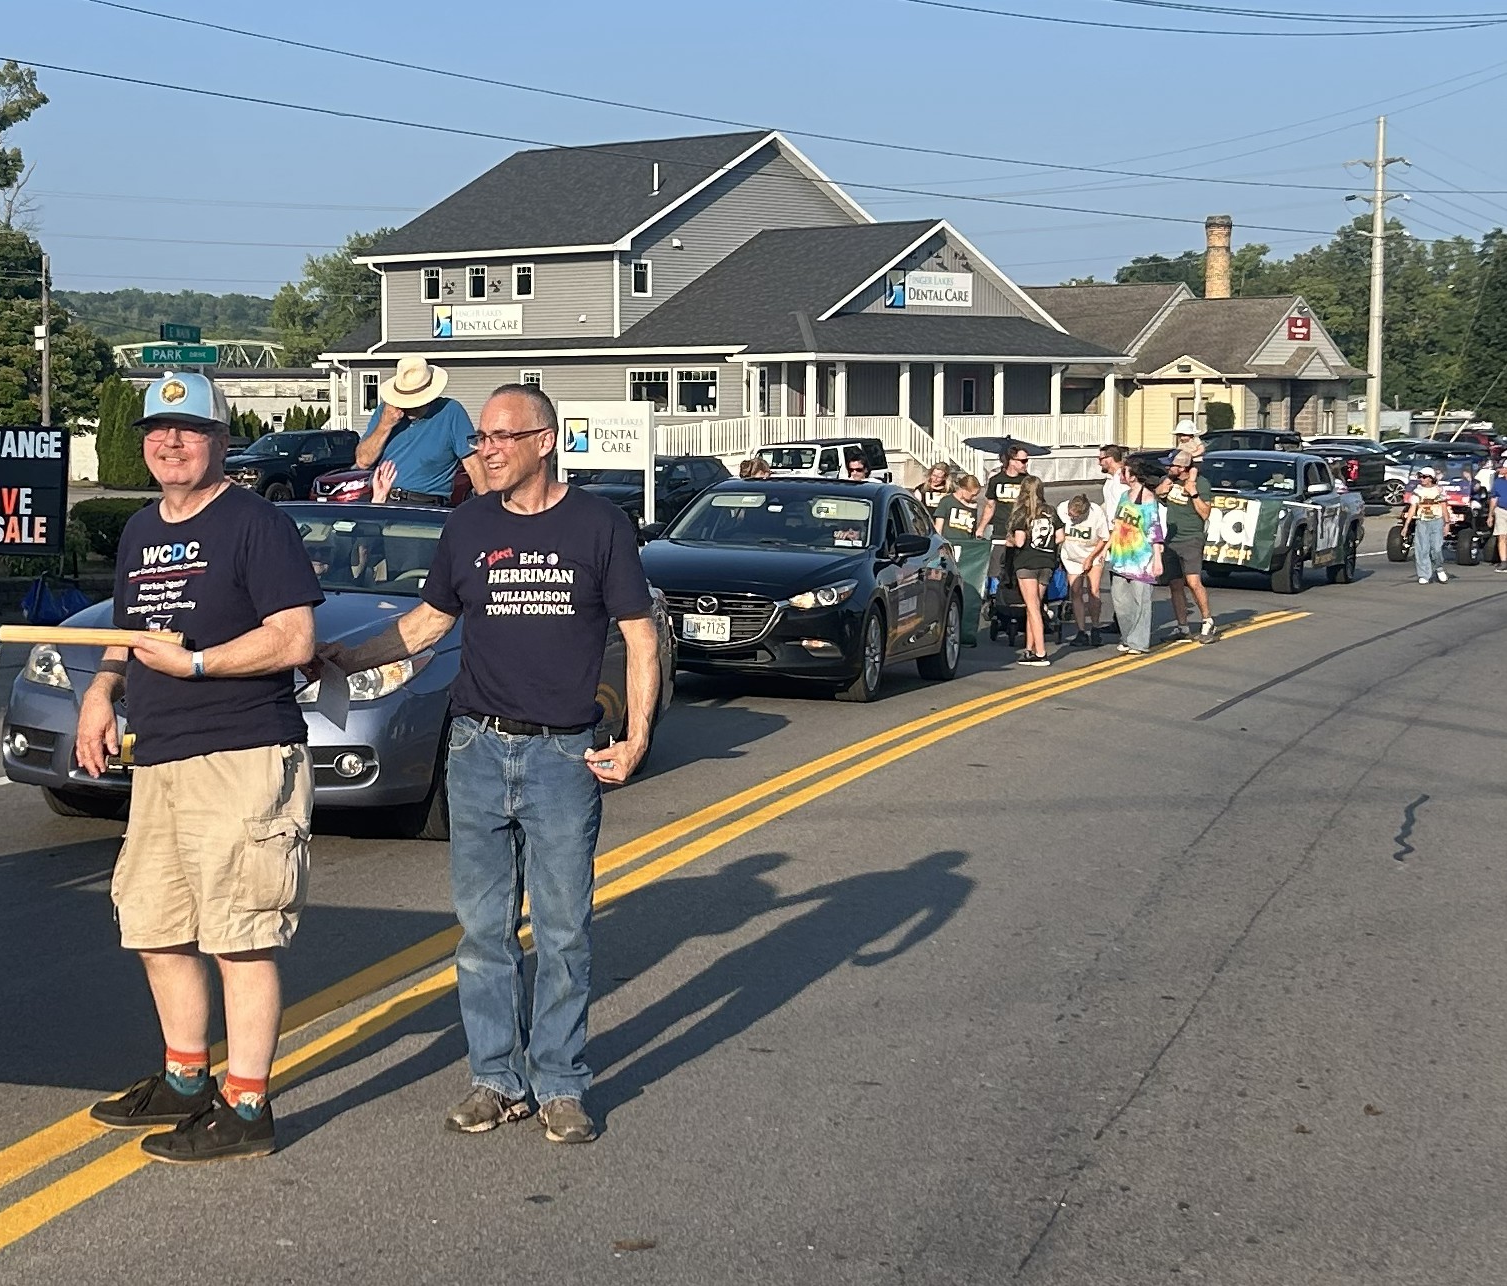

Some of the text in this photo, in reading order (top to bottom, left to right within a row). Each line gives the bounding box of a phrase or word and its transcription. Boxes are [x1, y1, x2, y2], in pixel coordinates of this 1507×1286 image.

[908, 287, 969, 302] DENTAL CARE
[456, 319, 518, 331] DENTAL CARE
[153, 349, 183, 360] PARK
[594, 427, 640, 440] DENTAL
[601, 441, 631, 453] CARE
[143, 541, 200, 566] WCDC
[519, 551, 545, 565] Eric
[488, 568, 574, 584] HERRIMAN
[491, 591, 571, 603] WILLIAMSON
[486, 604, 575, 616] TOWN COUNCIL
